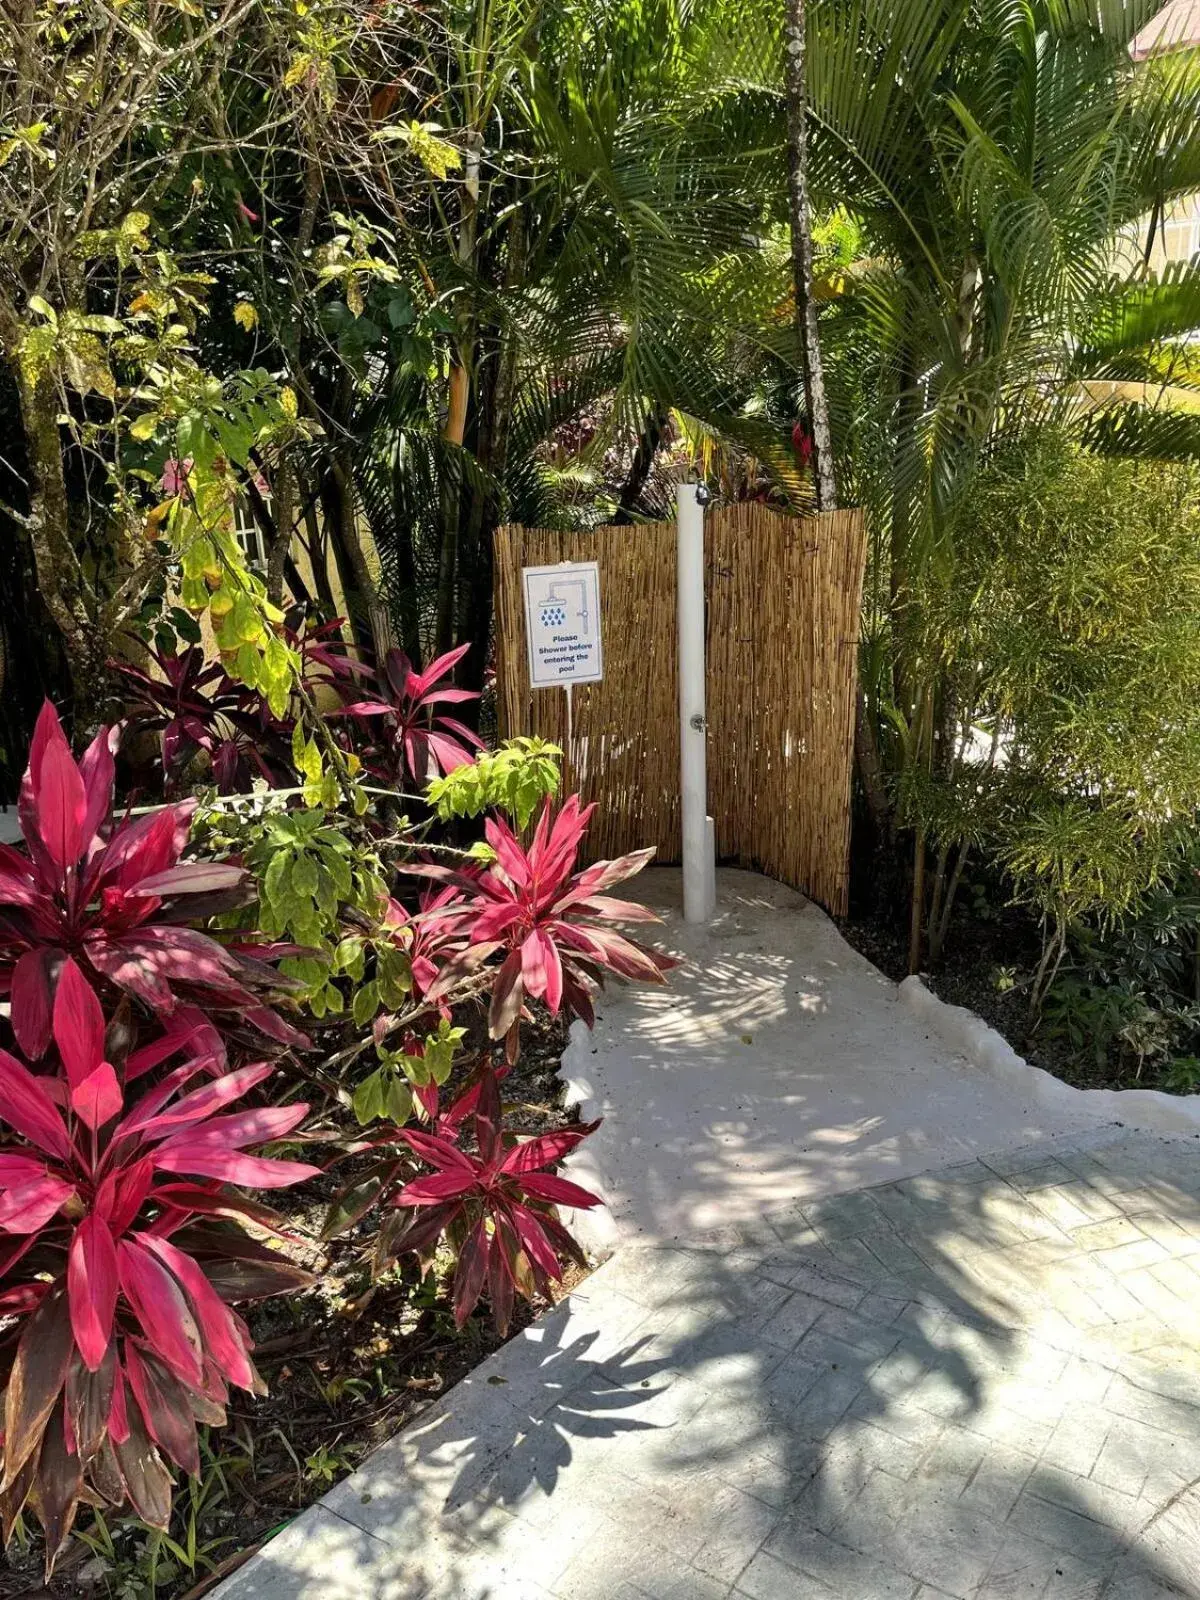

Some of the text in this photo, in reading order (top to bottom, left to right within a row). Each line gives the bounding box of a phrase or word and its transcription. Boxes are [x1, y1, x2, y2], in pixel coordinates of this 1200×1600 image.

[552, 635, 578, 643] Please
[539, 643, 593, 654] Shower before
[544, 655, 575, 664] entering
[558, 664, 575, 674] pool
